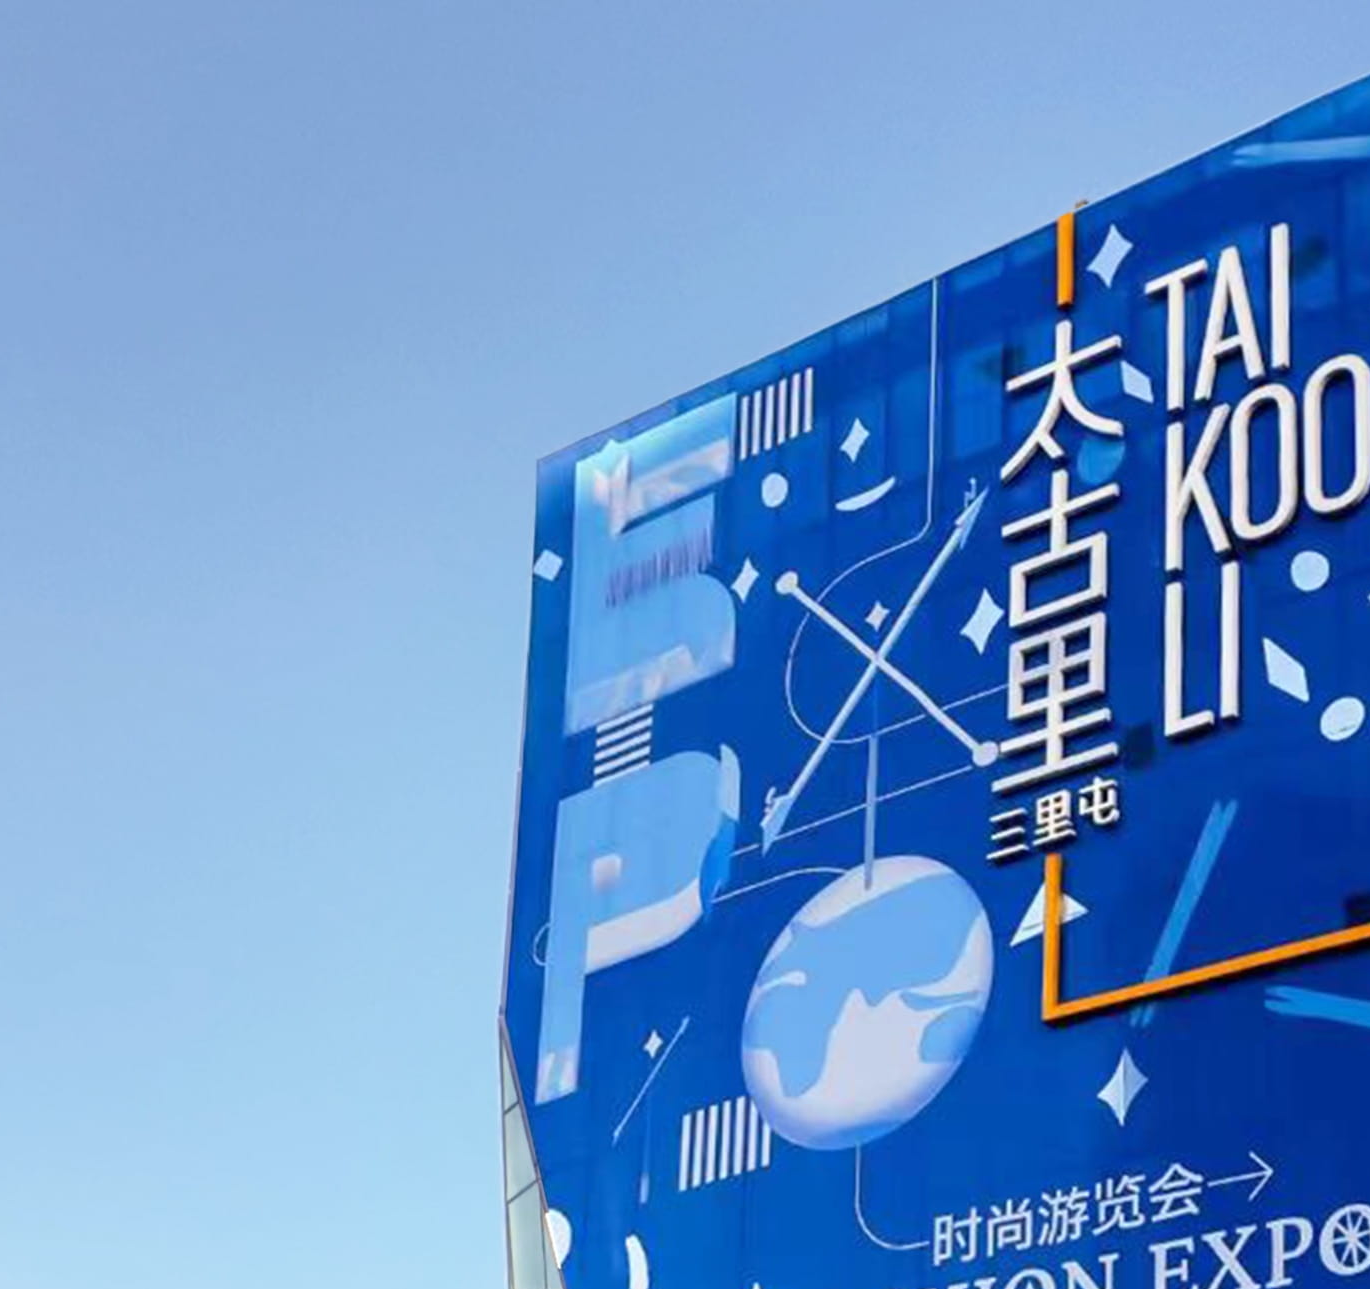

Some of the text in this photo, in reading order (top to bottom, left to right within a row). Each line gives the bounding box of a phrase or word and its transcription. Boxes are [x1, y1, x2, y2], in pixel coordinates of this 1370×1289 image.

[1144, 222, 1291, 412] TAI
[990, 319, 1125, 796] 太古里
[1163, 559, 1242, 742] LI
[985, 775, 1122, 863] 三里屯
[932, 1162, 1204, 1267] 时尚游览会
